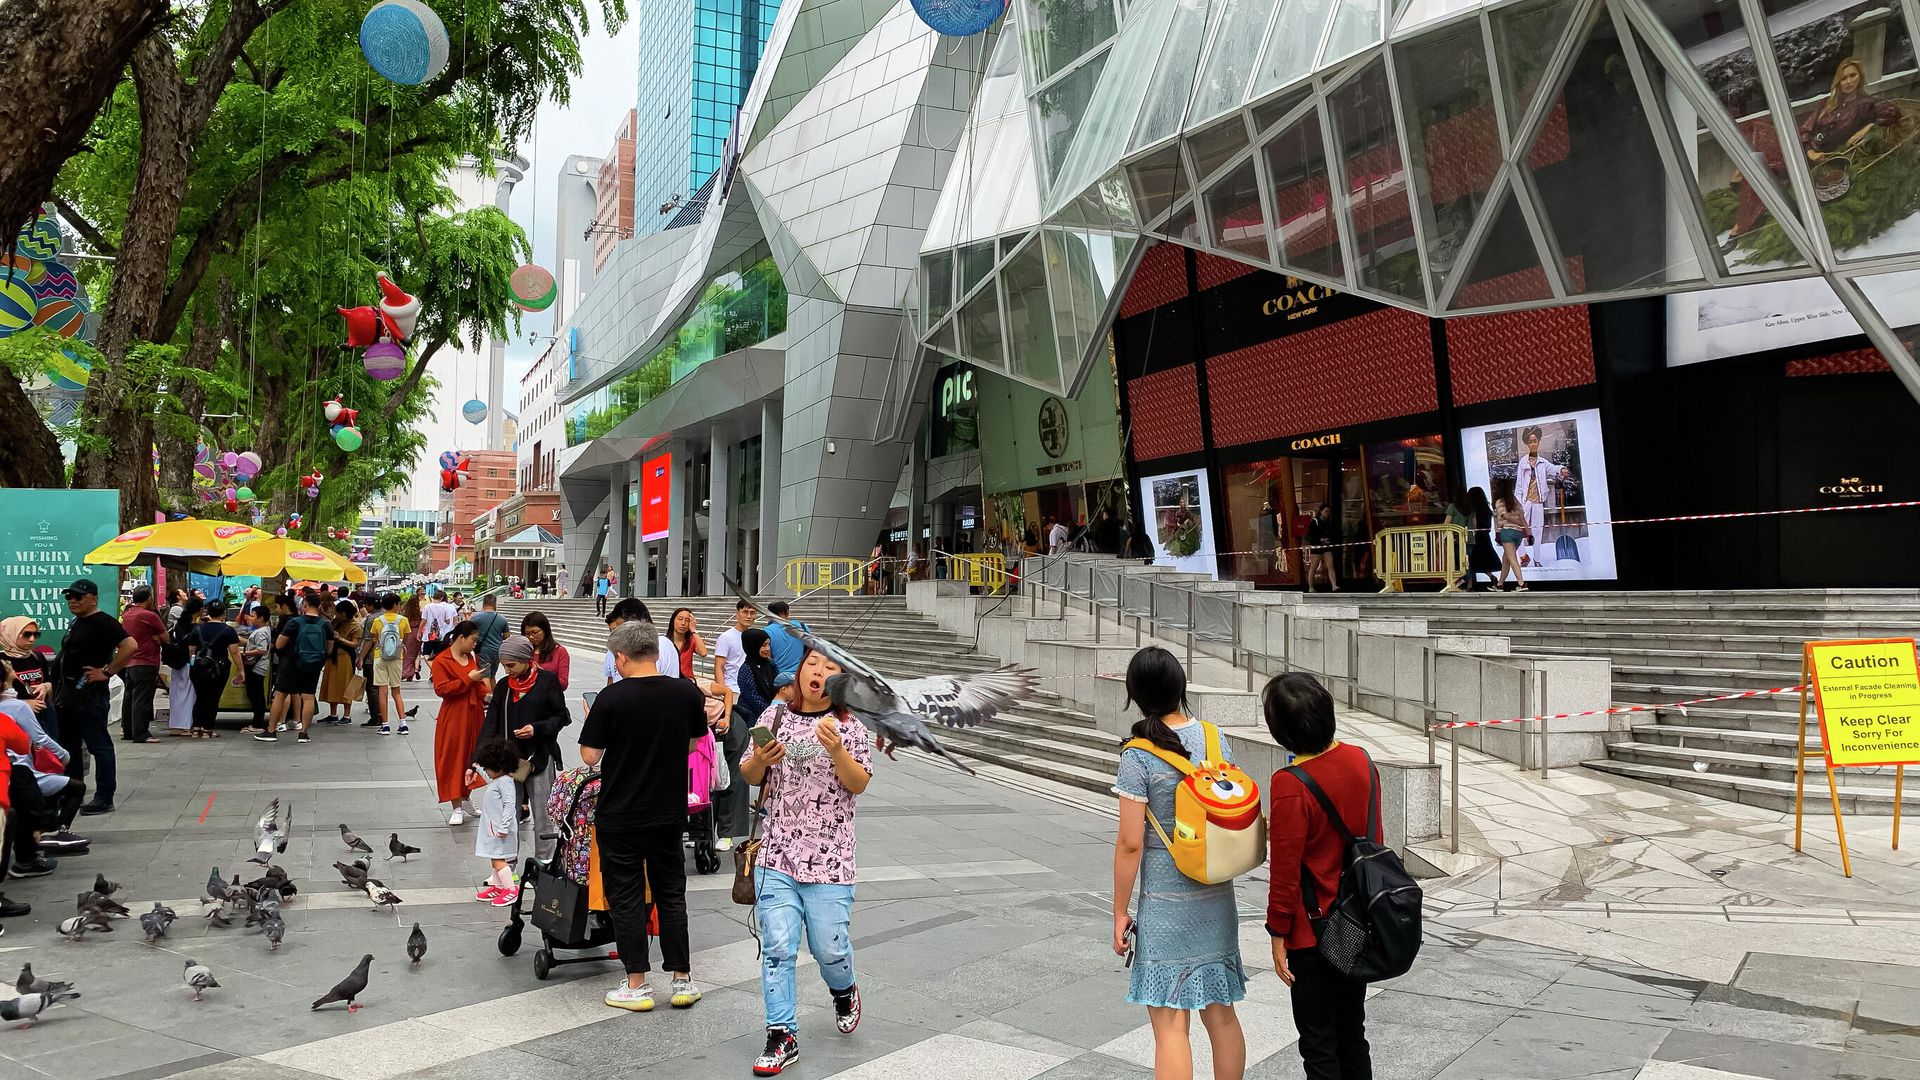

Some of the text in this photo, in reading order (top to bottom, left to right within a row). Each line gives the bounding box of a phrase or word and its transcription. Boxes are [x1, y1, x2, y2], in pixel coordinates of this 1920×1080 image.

[1288, 306, 1318, 320] NEW YORK
[1291, 433, 1341, 450] COACH
[1819, 484, 1883, 494] COACH
[15, 551, 72, 562] MERRY
[3, 565, 93, 576] HRISTMAS
[10, 587, 68, 601] HAPP
[22, 602, 65, 616] NEW
[36, 617, 71, 631] EAR
[1831, 655, 1899, 669] Caution
[20, 671, 42, 680] GUESS
[1883, 682, 1917, 690] Cleaning
[1849, 692, 1893, 700] in Progress
[1840, 714, 1911, 728] Keep Clear
[1852, 729, 1904, 740] Sorry For
[1841, 741, 1920, 752] Inconvenience
